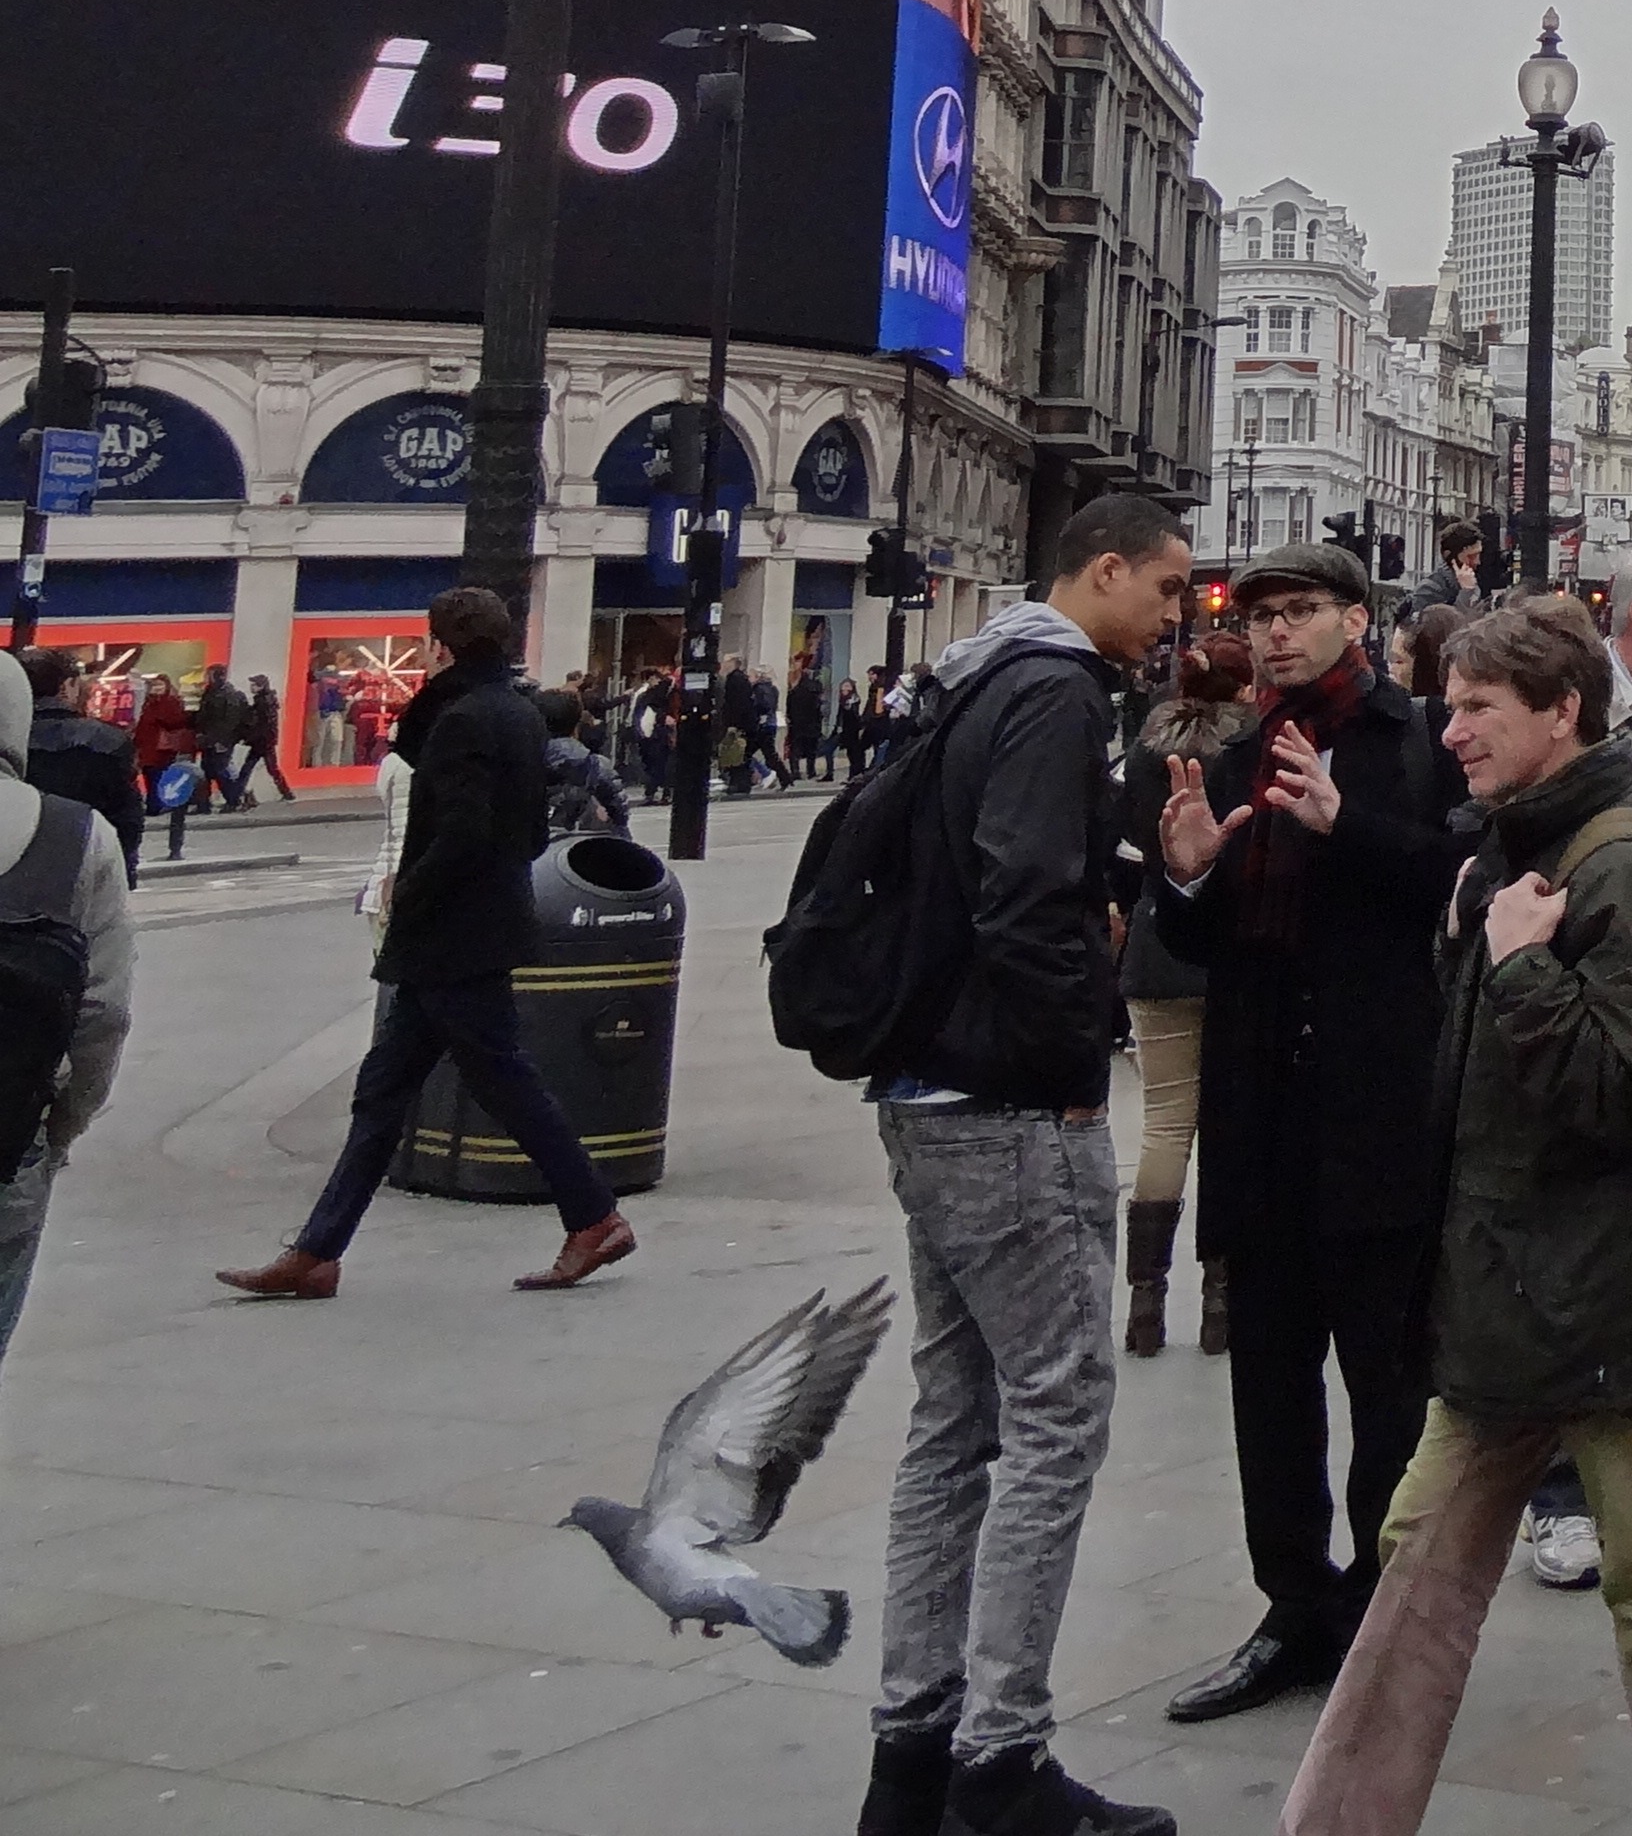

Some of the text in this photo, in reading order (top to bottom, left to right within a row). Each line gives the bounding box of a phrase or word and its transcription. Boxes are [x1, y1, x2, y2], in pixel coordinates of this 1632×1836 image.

[1597, 379, 1609, 435] APOLLO
[100, 423, 149, 457] AP
[399, 427, 464, 461] GAP
